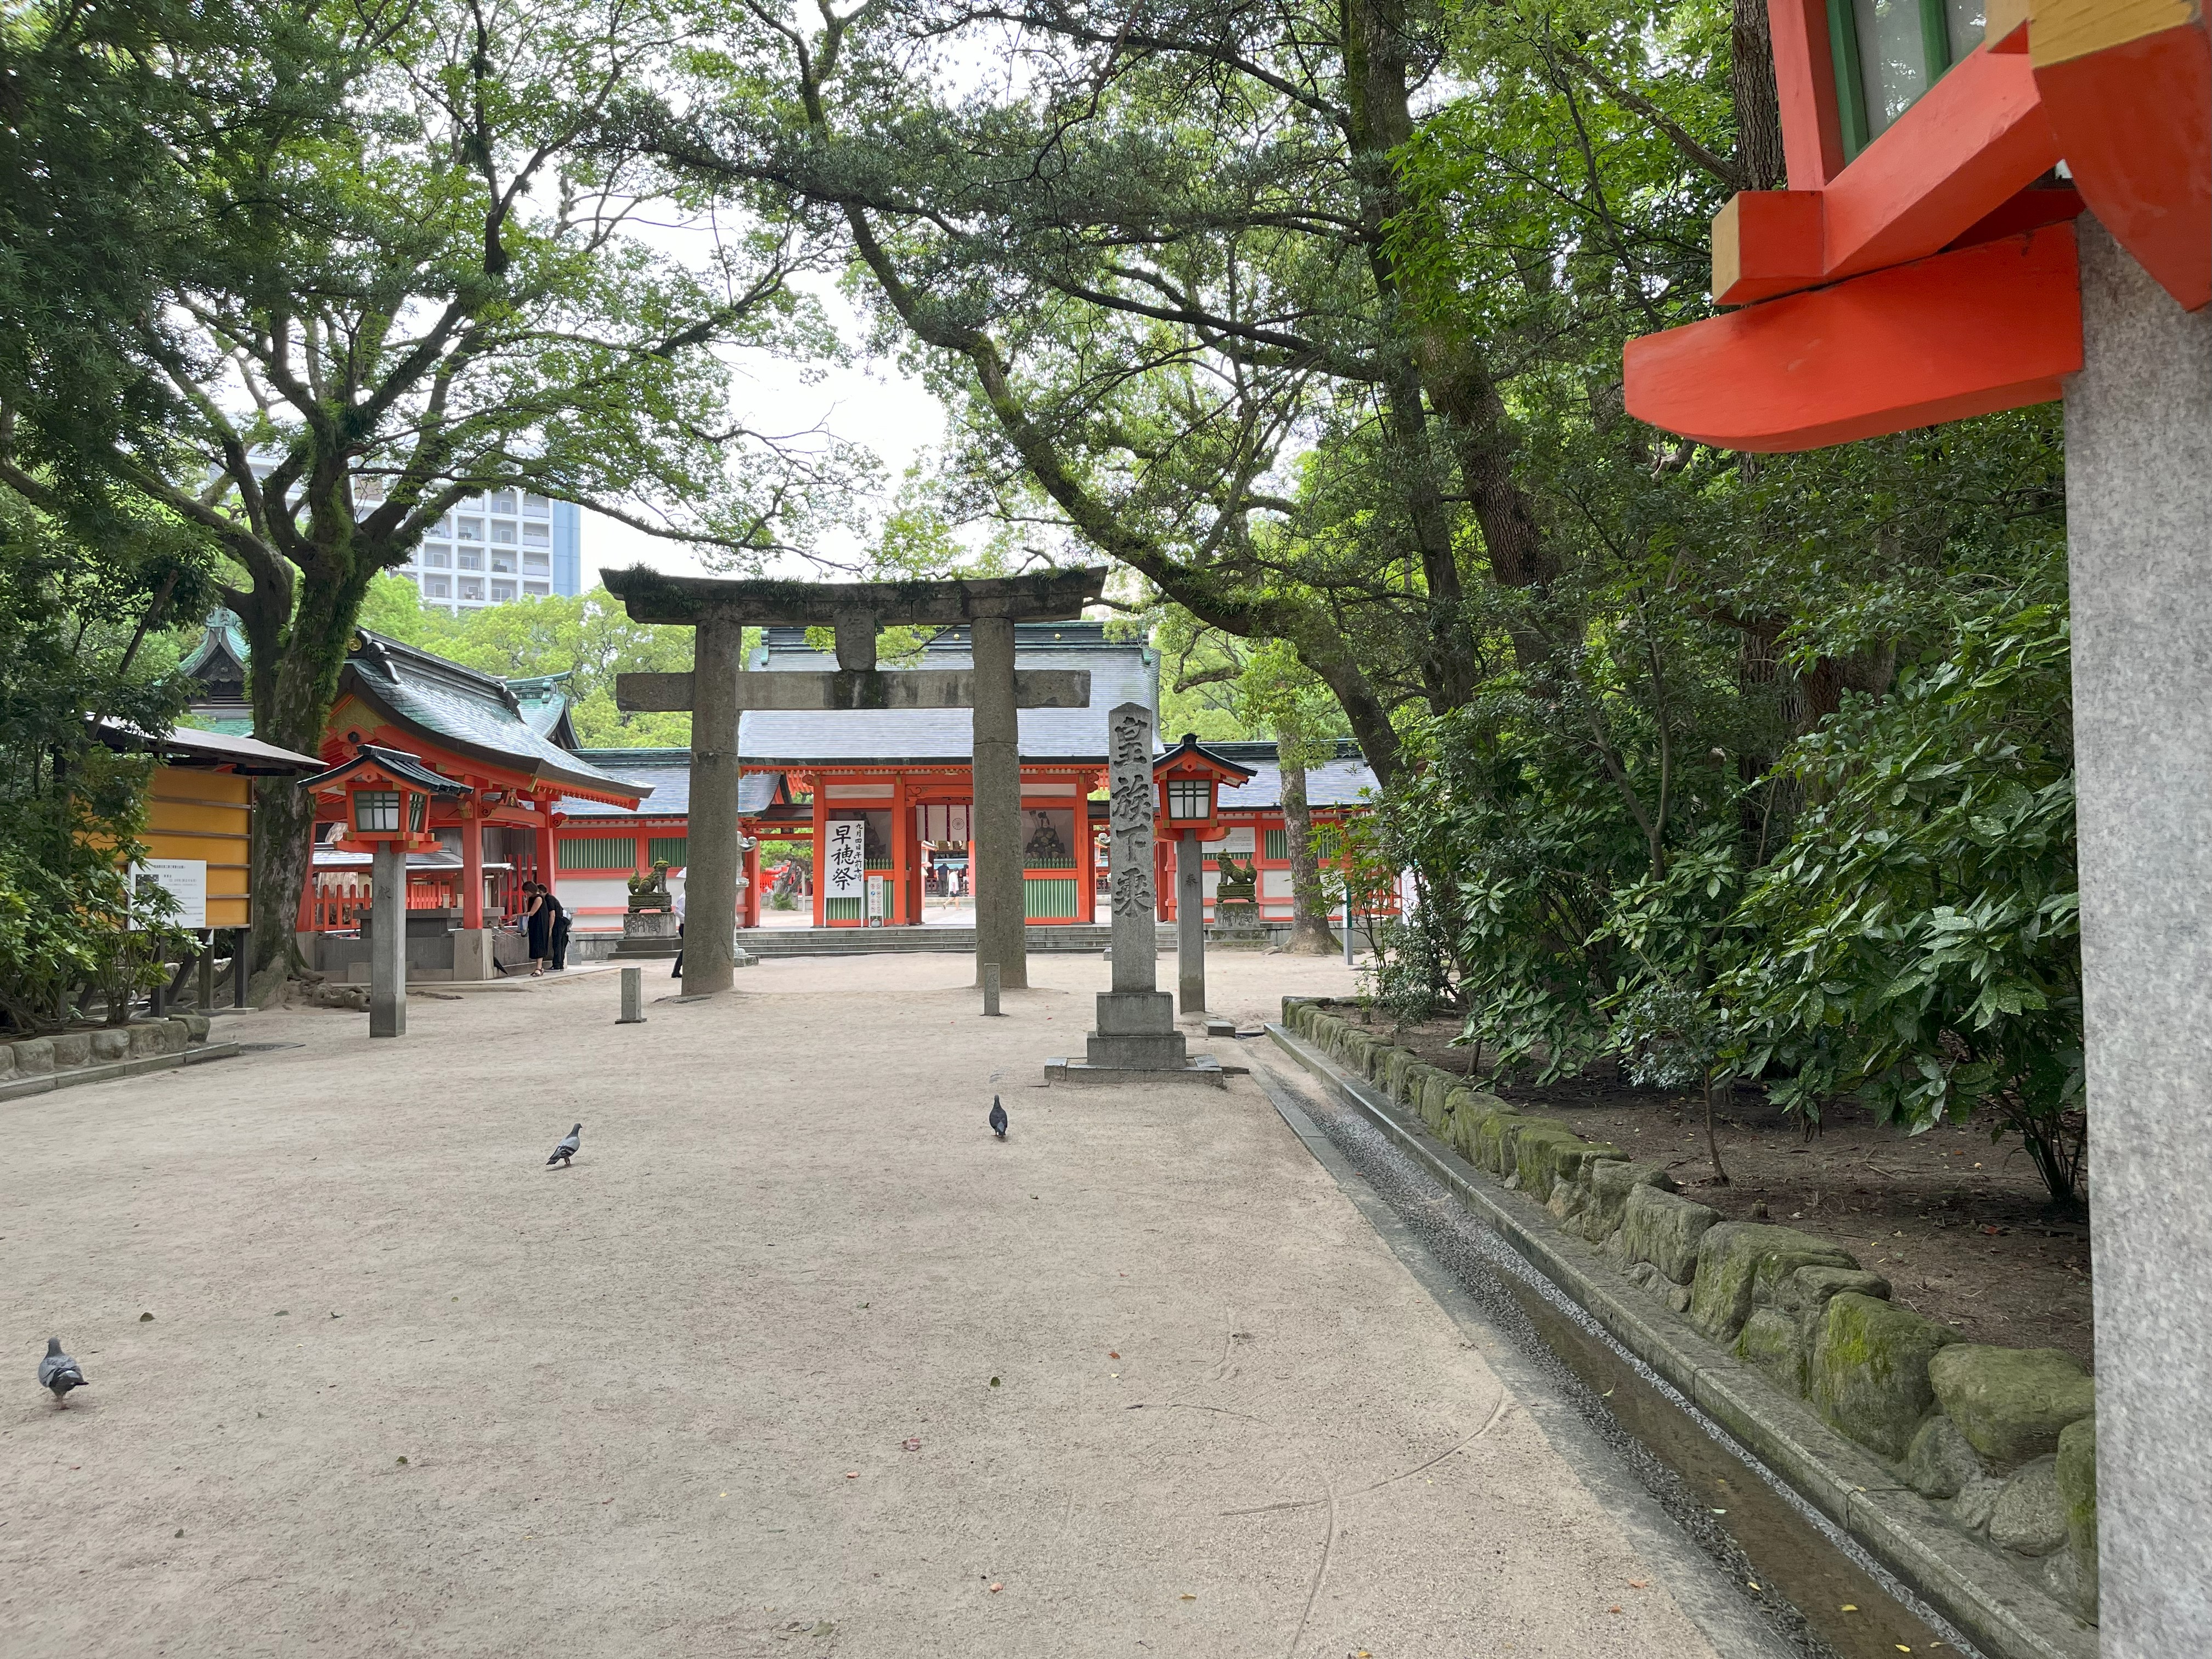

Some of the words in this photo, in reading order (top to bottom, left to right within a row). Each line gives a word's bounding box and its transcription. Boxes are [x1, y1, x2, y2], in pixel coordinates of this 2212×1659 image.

[1112, 716, 1153, 919] 皇族下乗
[831, 825, 856, 890] 早穂祭
[855, 823, 863, 882] 九月四日午前十時
